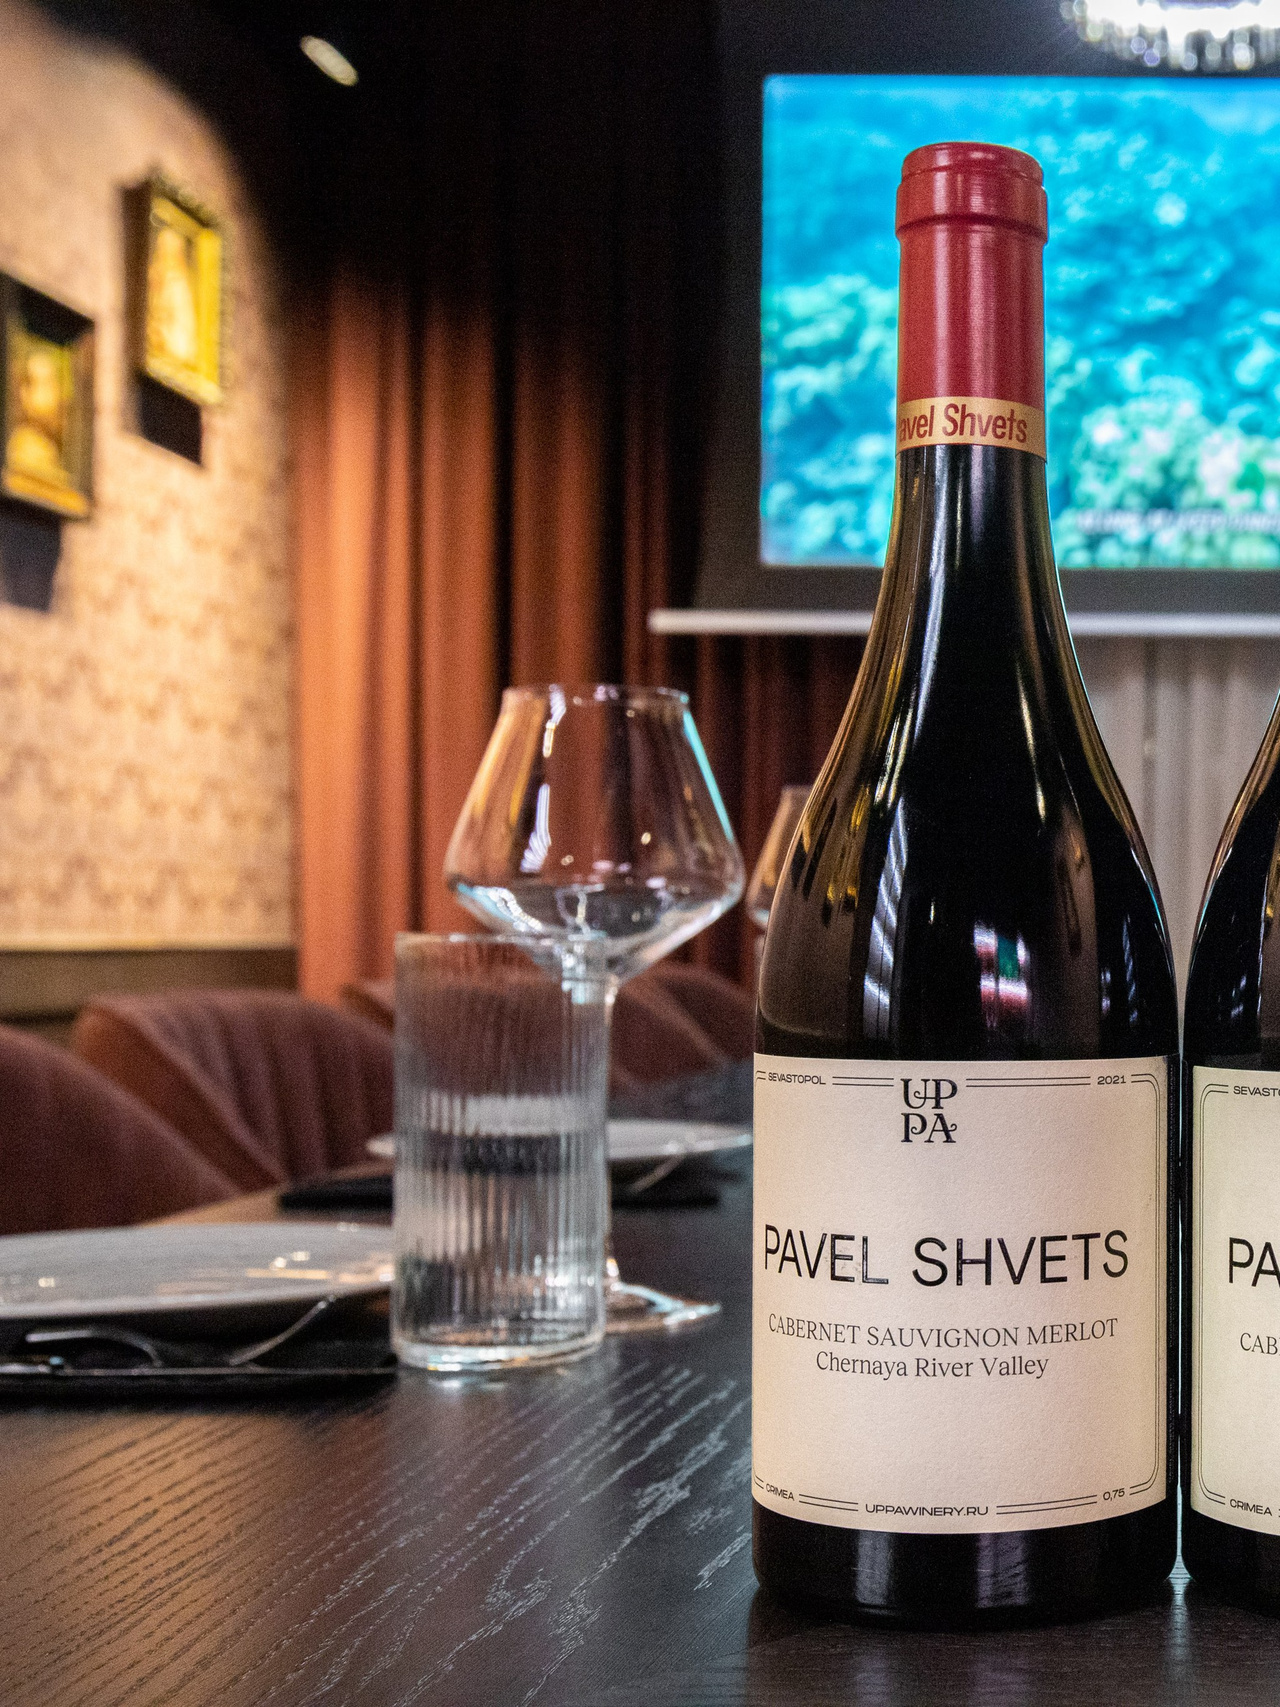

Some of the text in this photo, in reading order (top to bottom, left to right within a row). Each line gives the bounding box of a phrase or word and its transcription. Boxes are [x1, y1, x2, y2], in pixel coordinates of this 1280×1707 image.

[942, 403, 1028, 444] Shvets
[767, 1072, 826, 1086] SEVASTOPOL
[1097, 1075, 1127, 1086] 2021
[764, 1224, 1129, 1288] PAVEL SHVETS
[768, 1313, 1119, 1348] CABERNET SAUVIGNON MERLOT
[816, 1351, 1050, 1381] Chernaya River Valley
[765, 1483, 795, 1502] CRIMEA
[1102, 1487, 1126, 1502] 0,75
[865, 1503, 989, 1517] UPPAWINERY.RU
[1229, 1498, 1273, 1517] CRIMEA
